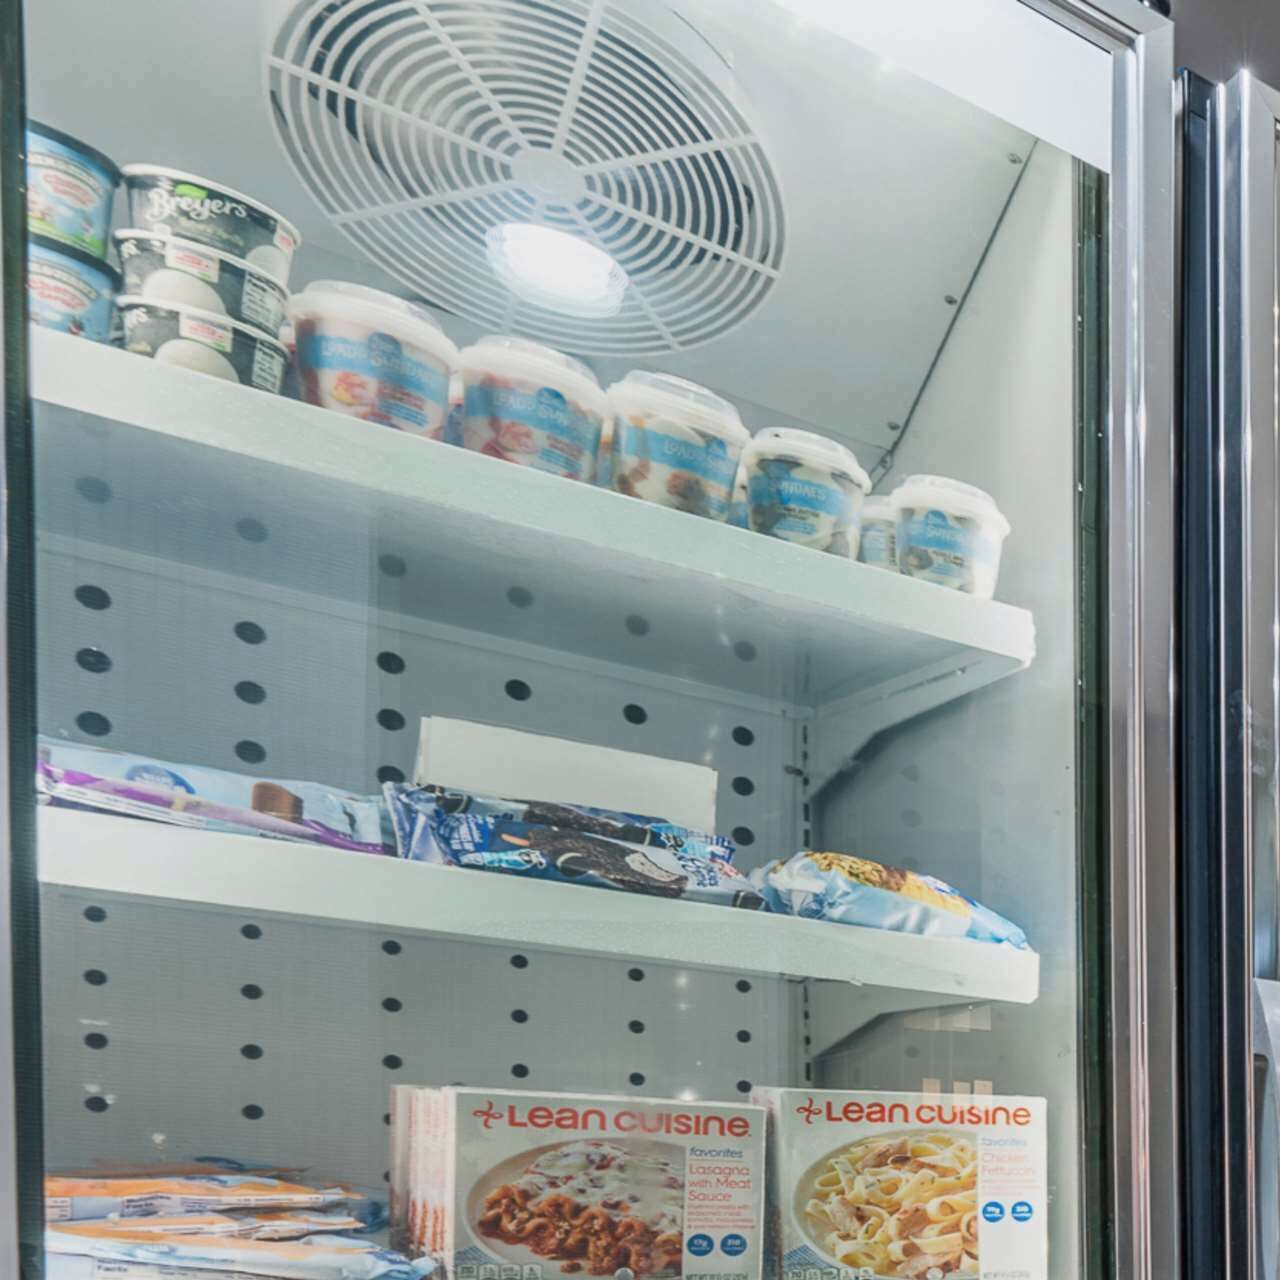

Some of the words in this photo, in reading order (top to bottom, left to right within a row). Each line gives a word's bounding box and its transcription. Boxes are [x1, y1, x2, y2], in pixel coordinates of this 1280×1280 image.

[146, 187, 248, 222] Breyers
[688, 1163, 750, 1176] Lasagna
[688, 1191, 733, 1201] Sauce
